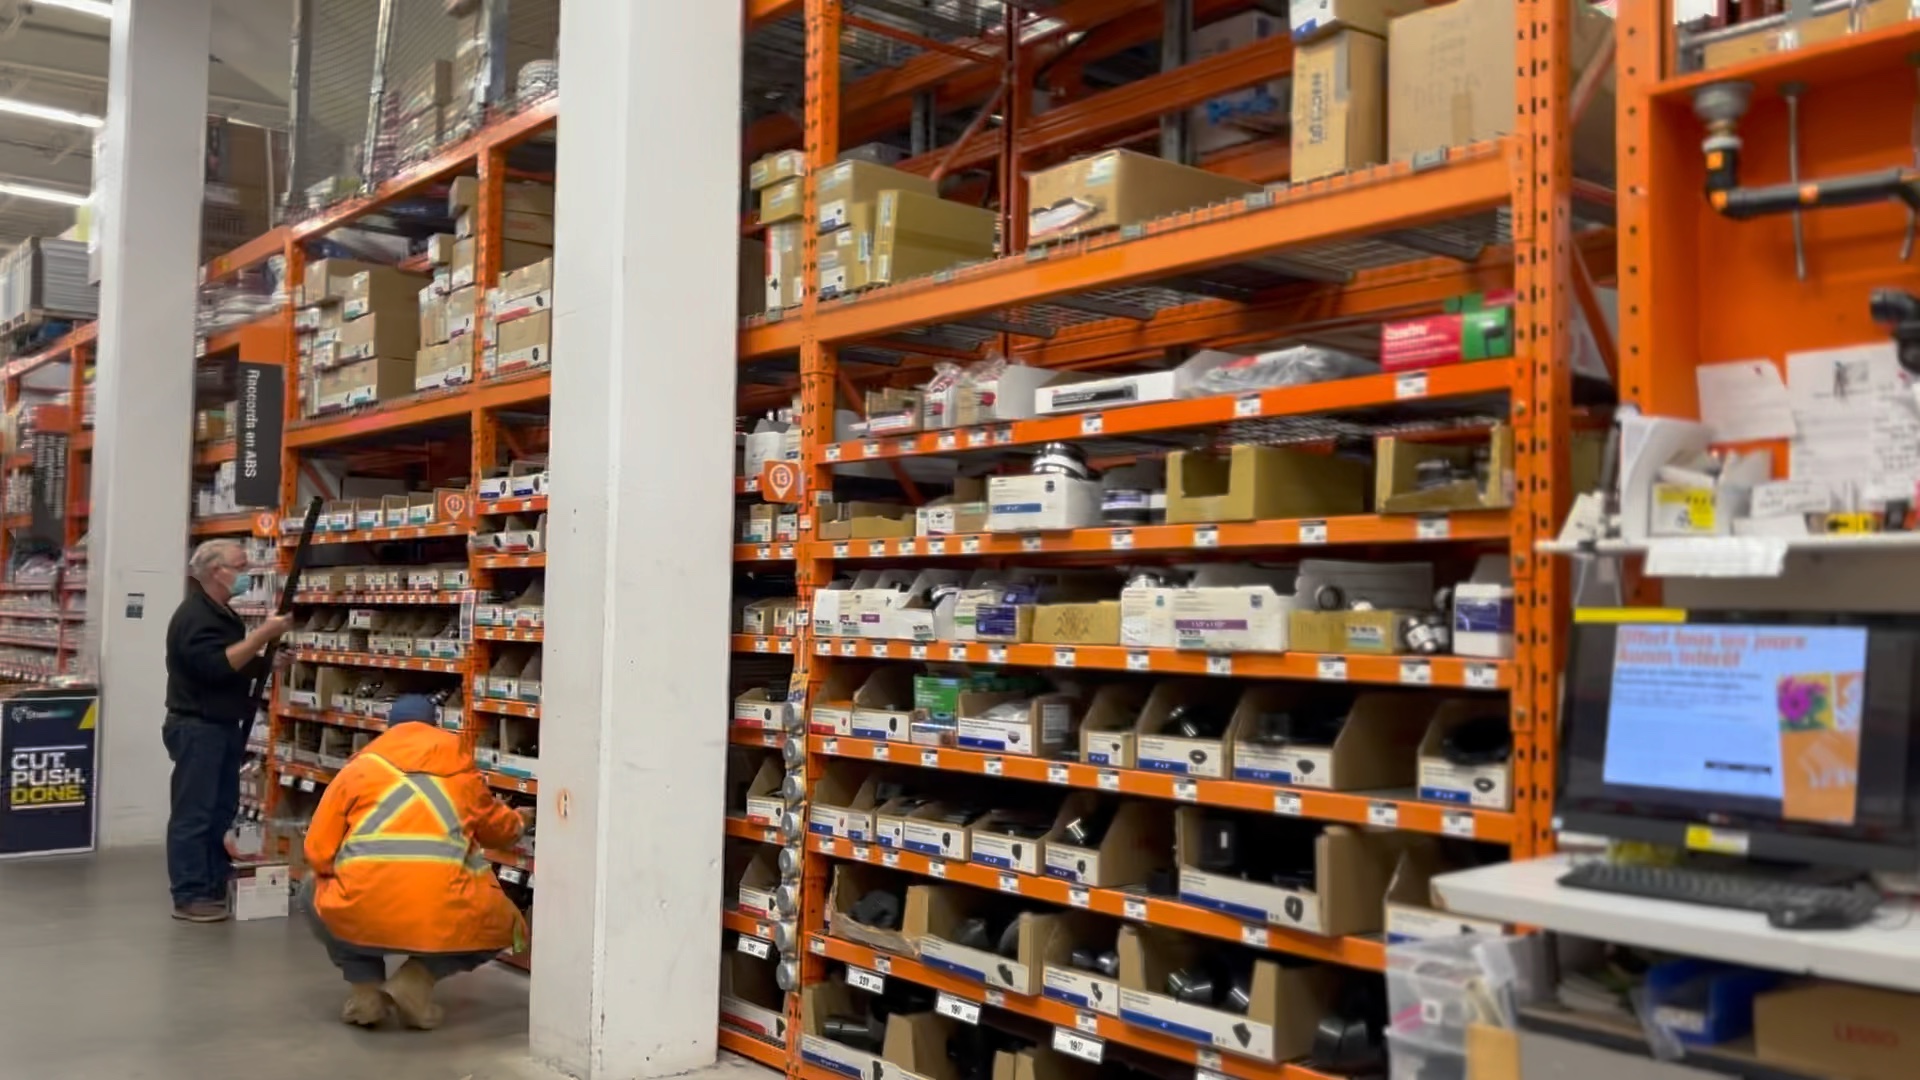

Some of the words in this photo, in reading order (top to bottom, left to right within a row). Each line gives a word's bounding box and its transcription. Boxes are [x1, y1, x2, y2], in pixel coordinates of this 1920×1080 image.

[246, 369, 260, 429] Raccords
[245, 431, 255, 447] en
[245, 450, 257, 478] ABS
[11, 752, 66, 770] CUT.
[11, 768, 86, 787] PUSH.
[10, 785, 86, 805] DONE.
